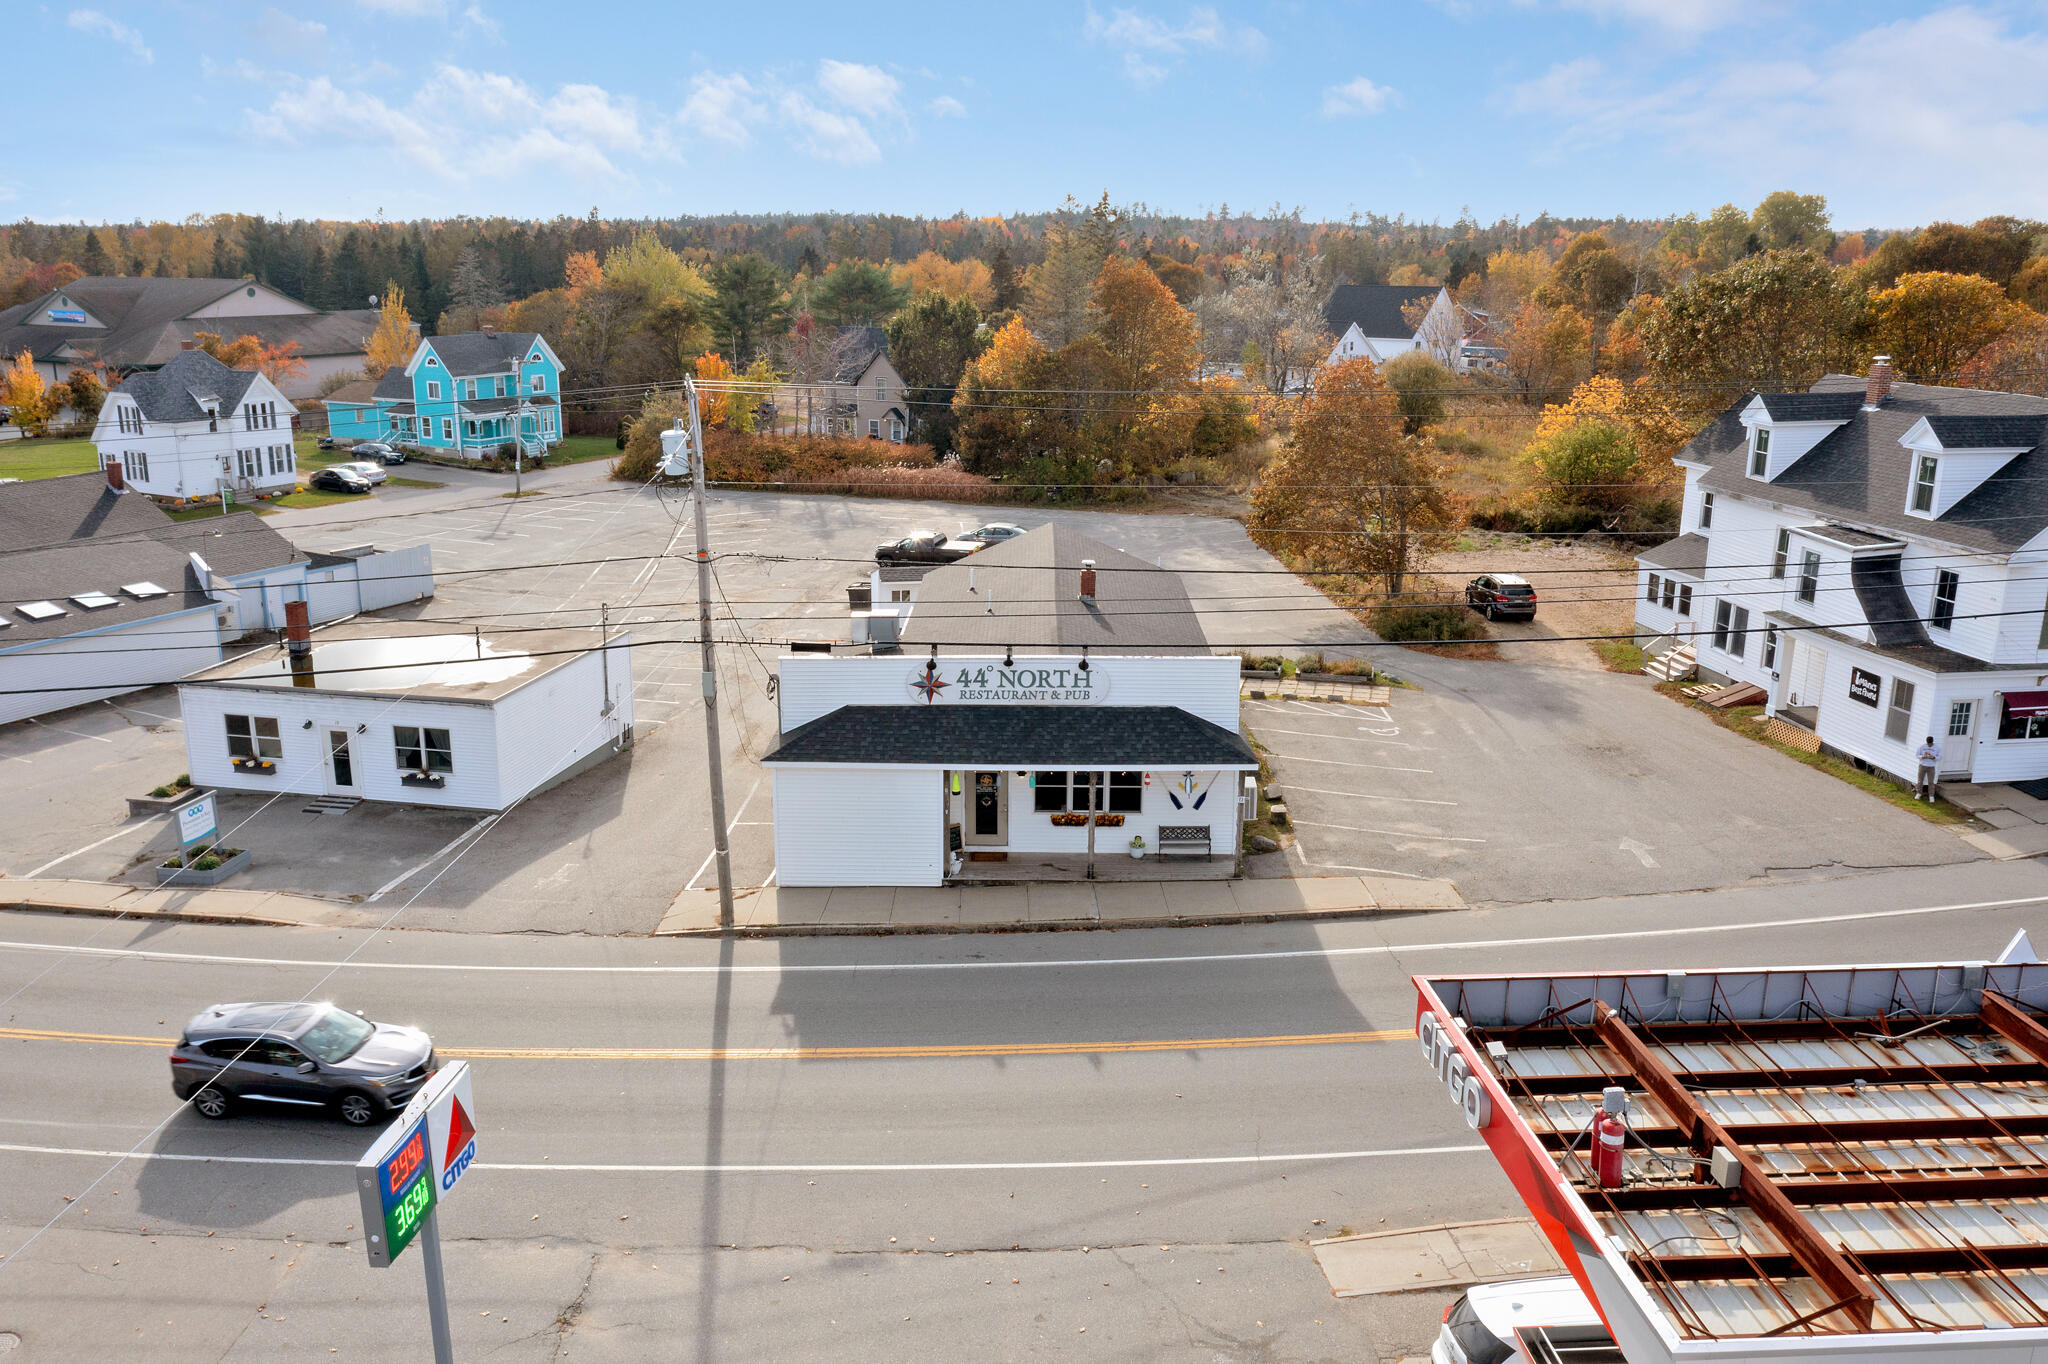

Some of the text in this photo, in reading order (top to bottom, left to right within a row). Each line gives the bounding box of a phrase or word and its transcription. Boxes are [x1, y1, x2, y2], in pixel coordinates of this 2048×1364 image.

[959, 690, 1091, 701] RESTAURANT & PUB
[997, 669, 1093, 689] NORTH
[1419, 1011, 1491, 1129] CITGO
[442, 1140, 475, 1190] CITGO
